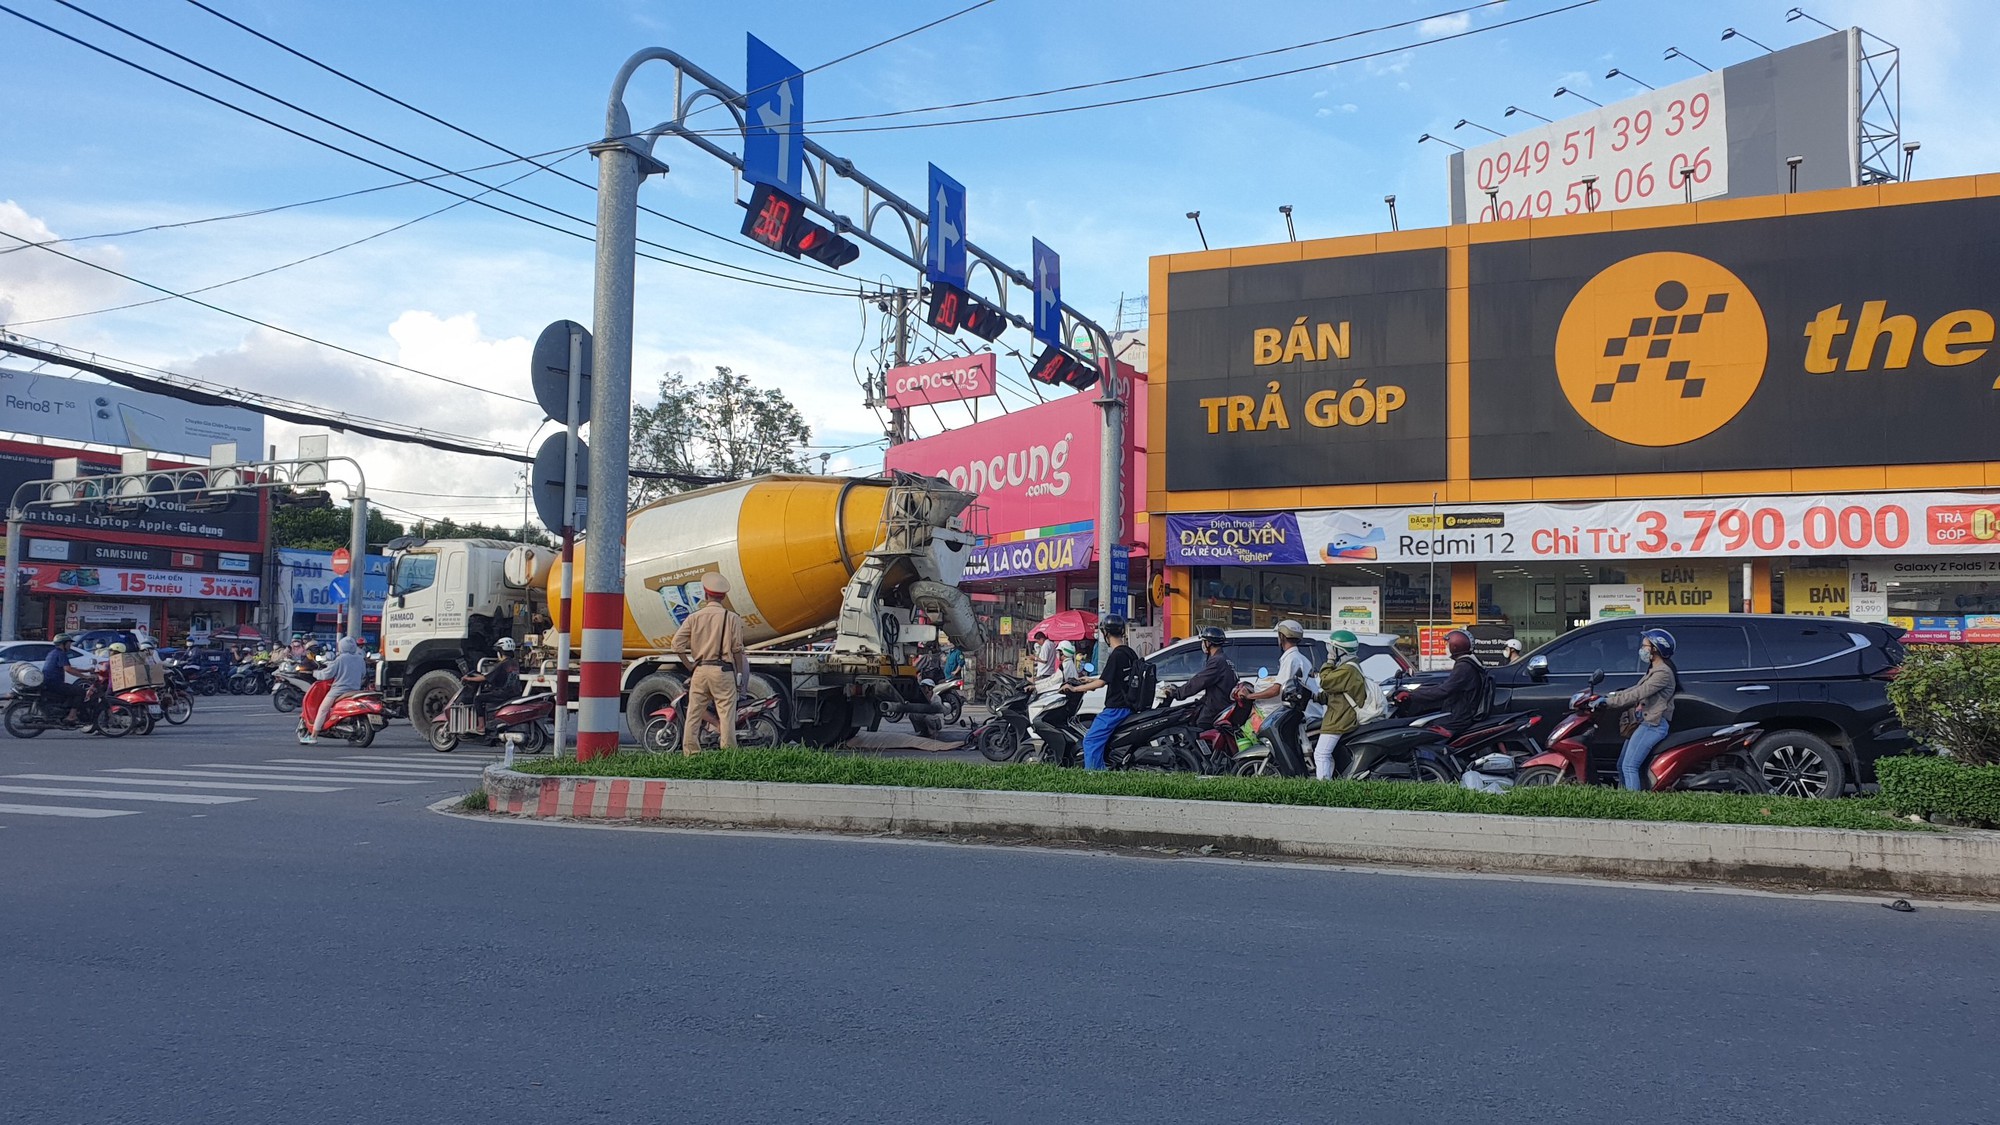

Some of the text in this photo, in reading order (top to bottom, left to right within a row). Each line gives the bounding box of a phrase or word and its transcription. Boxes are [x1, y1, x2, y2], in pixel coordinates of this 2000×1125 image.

[1477, 92, 1710, 190] 0949 51 39 39
[1564, 176, 1602, 216] 56
[1614, 162, 1655, 203] 06
[1668, 146, 1712, 190] 06
[754, 194, 791, 242] 30
[1253, 316, 1350, 366] BÁN
[1803, 300, 2000, 390] the
[896, 366, 979, 394] concung
[6, 394, 50, 413] Reno8
[54, 402, 63, 414] T
[1199, 378, 1407, 434] TRẢ GÓP
[1026, 483, 1050, 498] .com
[42, 511, 76, 524] thoại
[86, 515, 129, 528] Laptop
[139, 521, 172, 531] Apple
[179, 522, 197, 533] Gia
[199, 525, 223, 537] dụng
[1211, 520, 1231, 529] Điện
[1411, 516, 1425, 525] ĐẶC
[1936, 510, 1963, 523] TRẢ
[1180, 522, 1285, 548] ĐẶC QUYỀN
[1531, 505, 1910, 554] Chỉ Từ 3.790.000
[1936, 527, 1966, 540] GÓP
[34, 544, 65, 553] oppo
[95, 547, 148, 560] SAMSUNG
[1181, 546, 1197, 556] GIÁ
[1199, 545, 1209, 556] RẺ
[1211, 545, 1232, 557] QUÁ
[1400, 532, 1514, 556] Redmi 12
[293, 559, 322, 578] BÁN
[963, 554, 990, 576] MUA
[993, 548, 1009, 572] LÀ
[1012, 543, 1032, 570] CÓ
[1894, 561, 1996, 573] Galaxy Z Fold5 Z
[117, 572, 146, 592] 15
[168, 573, 183, 581] ĐẾN
[1661, 564, 1695, 583] BÁN
[147, 583, 183, 595] TRIỆU
[199, 577, 216, 596] 3
[216, 583, 252, 598] NĂM
[310, 585, 334, 605] GÓ
[1644, 586, 1713, 605] TRẢ GÓP
[1809, 583, 1845, 603] BÁN
[390, 612, 414, 621] HAMACO
